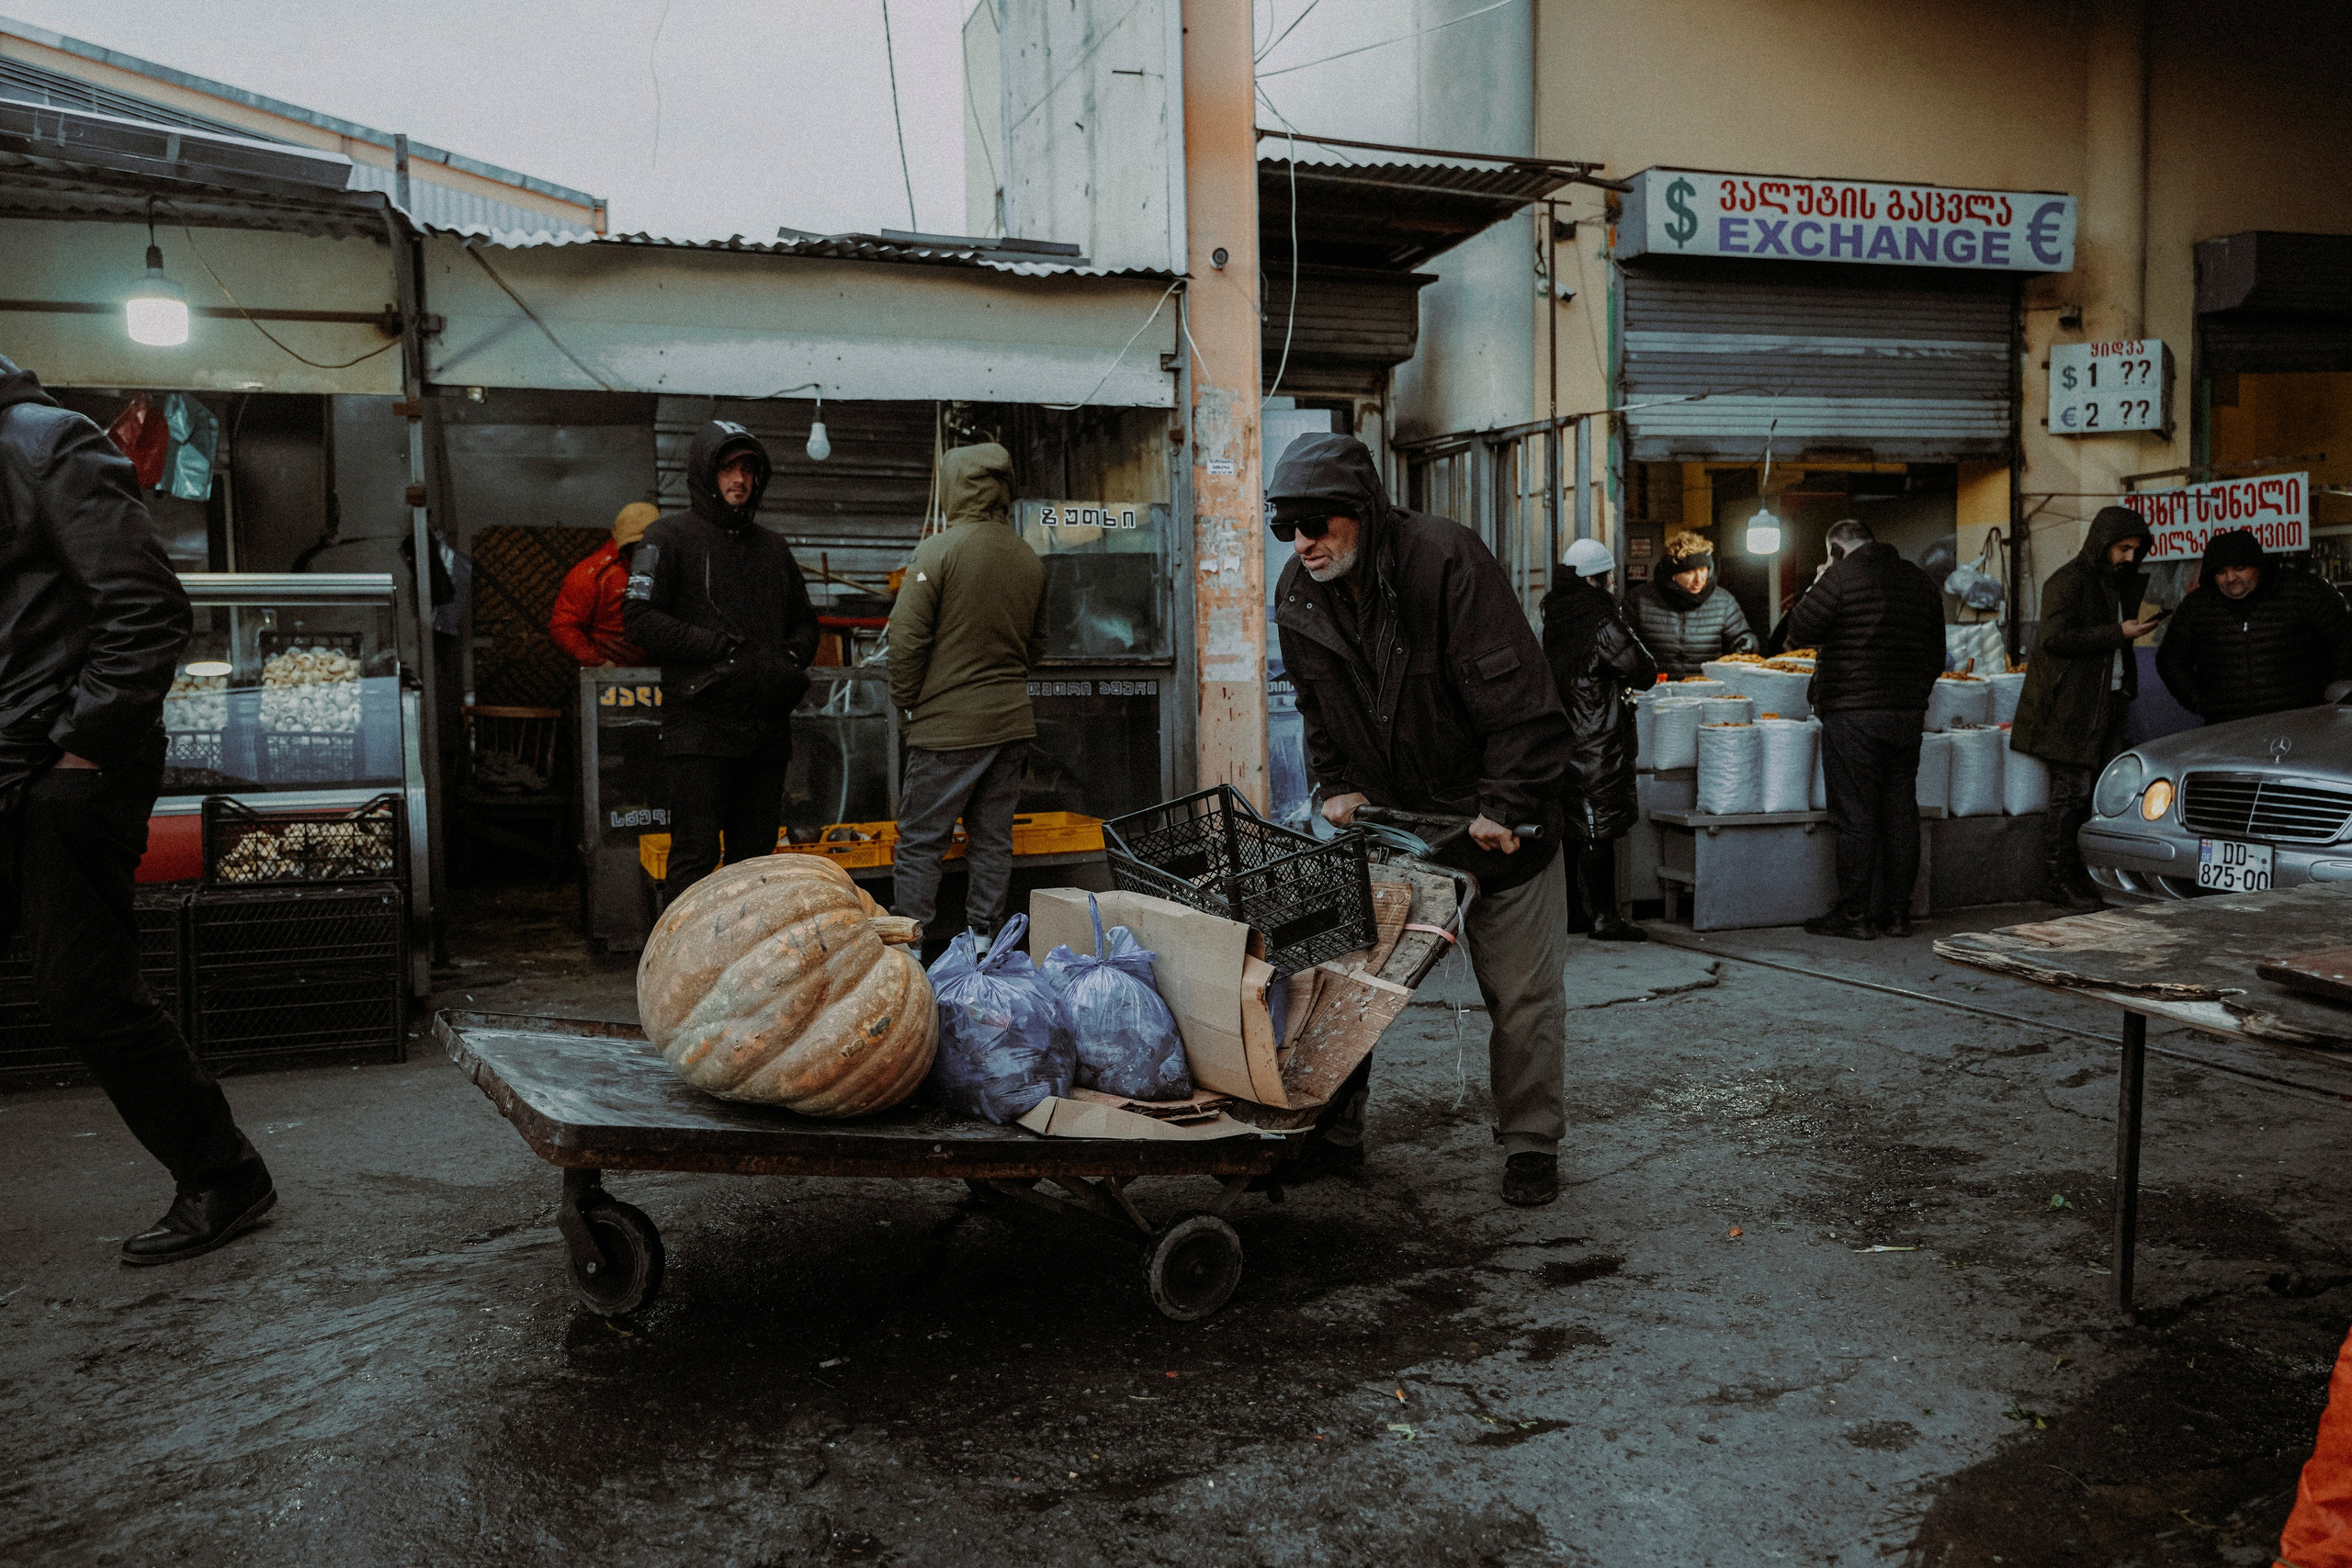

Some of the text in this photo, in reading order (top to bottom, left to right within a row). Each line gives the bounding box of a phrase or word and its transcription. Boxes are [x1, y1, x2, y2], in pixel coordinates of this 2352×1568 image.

[1720, 180, 2012, 227] ვალუტის გაცვლა
[1719, 218, 2011, 265] EXCHANGE
[2086, 363, 2098, 388] 1
[2086, 402, 2099, 428] 2
[2196, 478, 2301, 522] სუნელი
